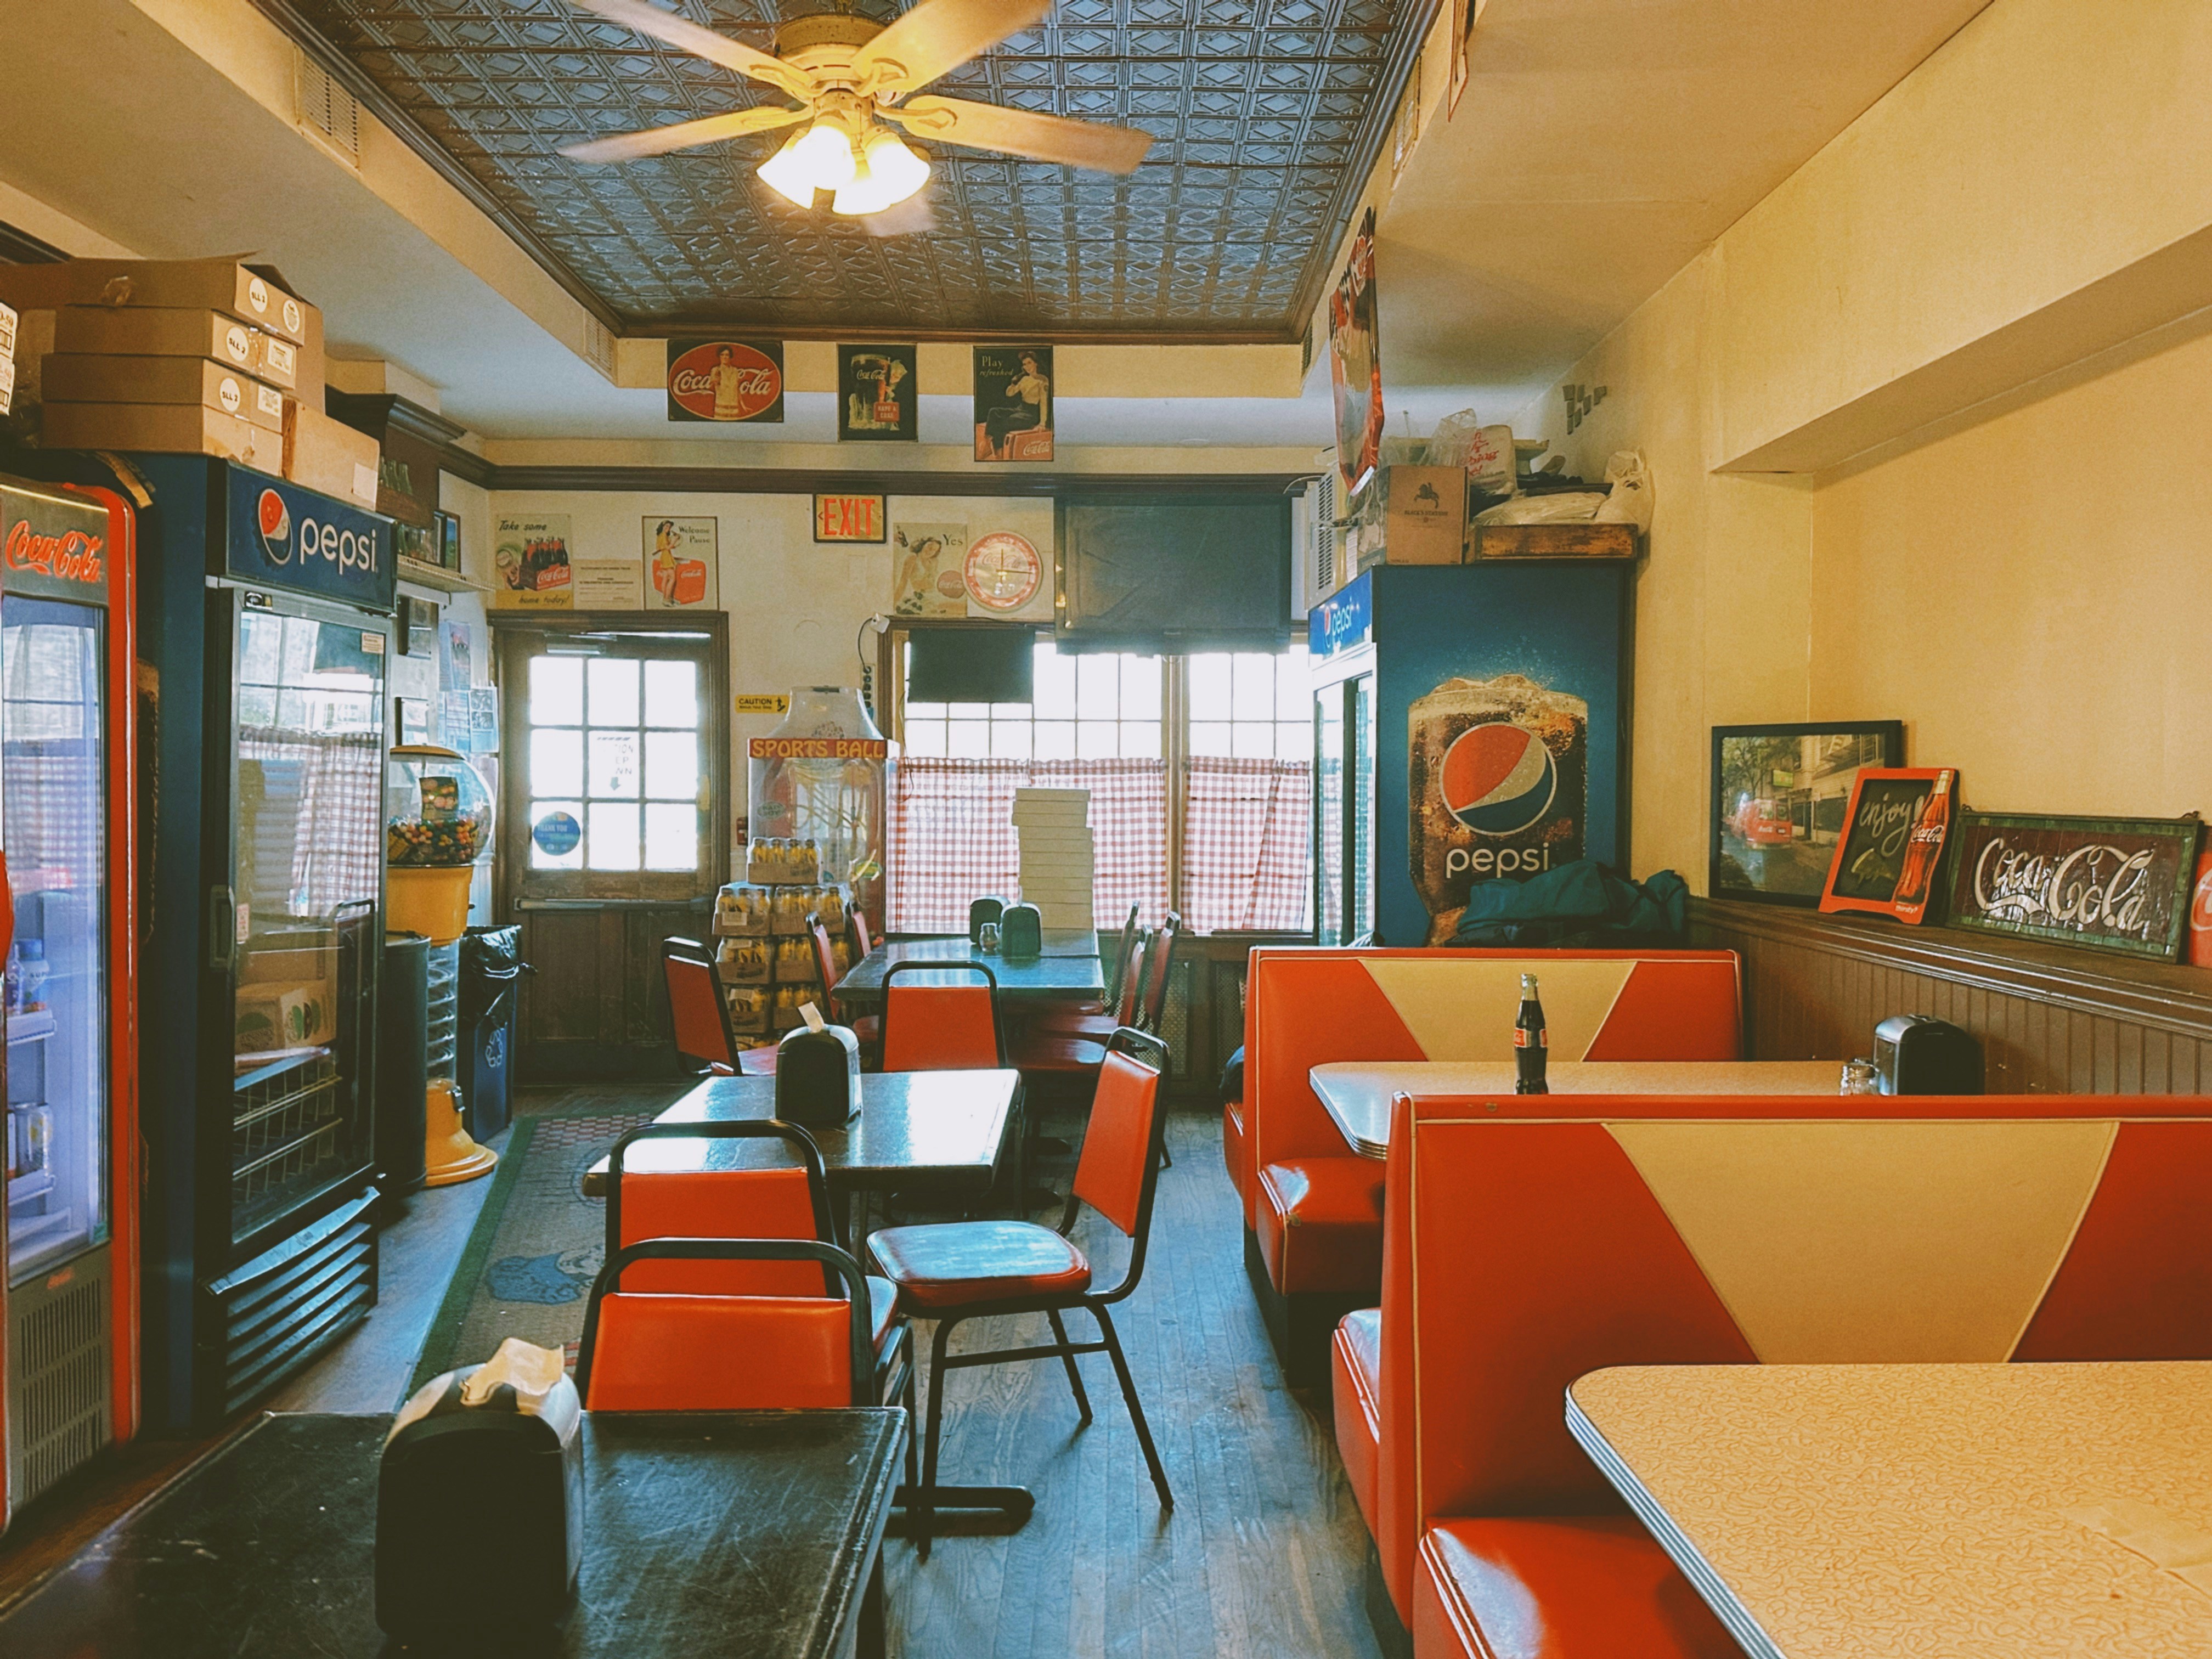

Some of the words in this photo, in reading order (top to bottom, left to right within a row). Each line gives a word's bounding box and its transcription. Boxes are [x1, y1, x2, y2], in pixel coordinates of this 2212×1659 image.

[251, 291, 261, 302] SLL
[228, 337, 240, 351] SLL
[981, 355, 1003, 368] Play
[979, 368, 1014, 377] refreshed
[673, 369, 715, 396] Coca
[737, 368, 776, 395] ola
[222, 391, 233, 402] SLL
[824, 498, 876, 535] EXIT
[499, 520, 519, 531] Take
[679, 526, 710, 534] Welcome
[300, 517, 377, 575] pepsi
[689, 535, 710, 544] Pause
[943, 534, 963, 546] Yes
[5, 520, 103, 583] Coca-Cola
[519, 595, 539, 603] home
[544, 594, 571, 606] today!
[1332, 596, 1352, 647] pepsi
[752, 741, 828, 758] SPORTS
[836, 741, 884, 758] BALL
[1446, 842, 1549, 878] pepsi
[1975, 837, 2155, 931] Coca-Cola
[1895, 905, 1918, 914] thirsty?
